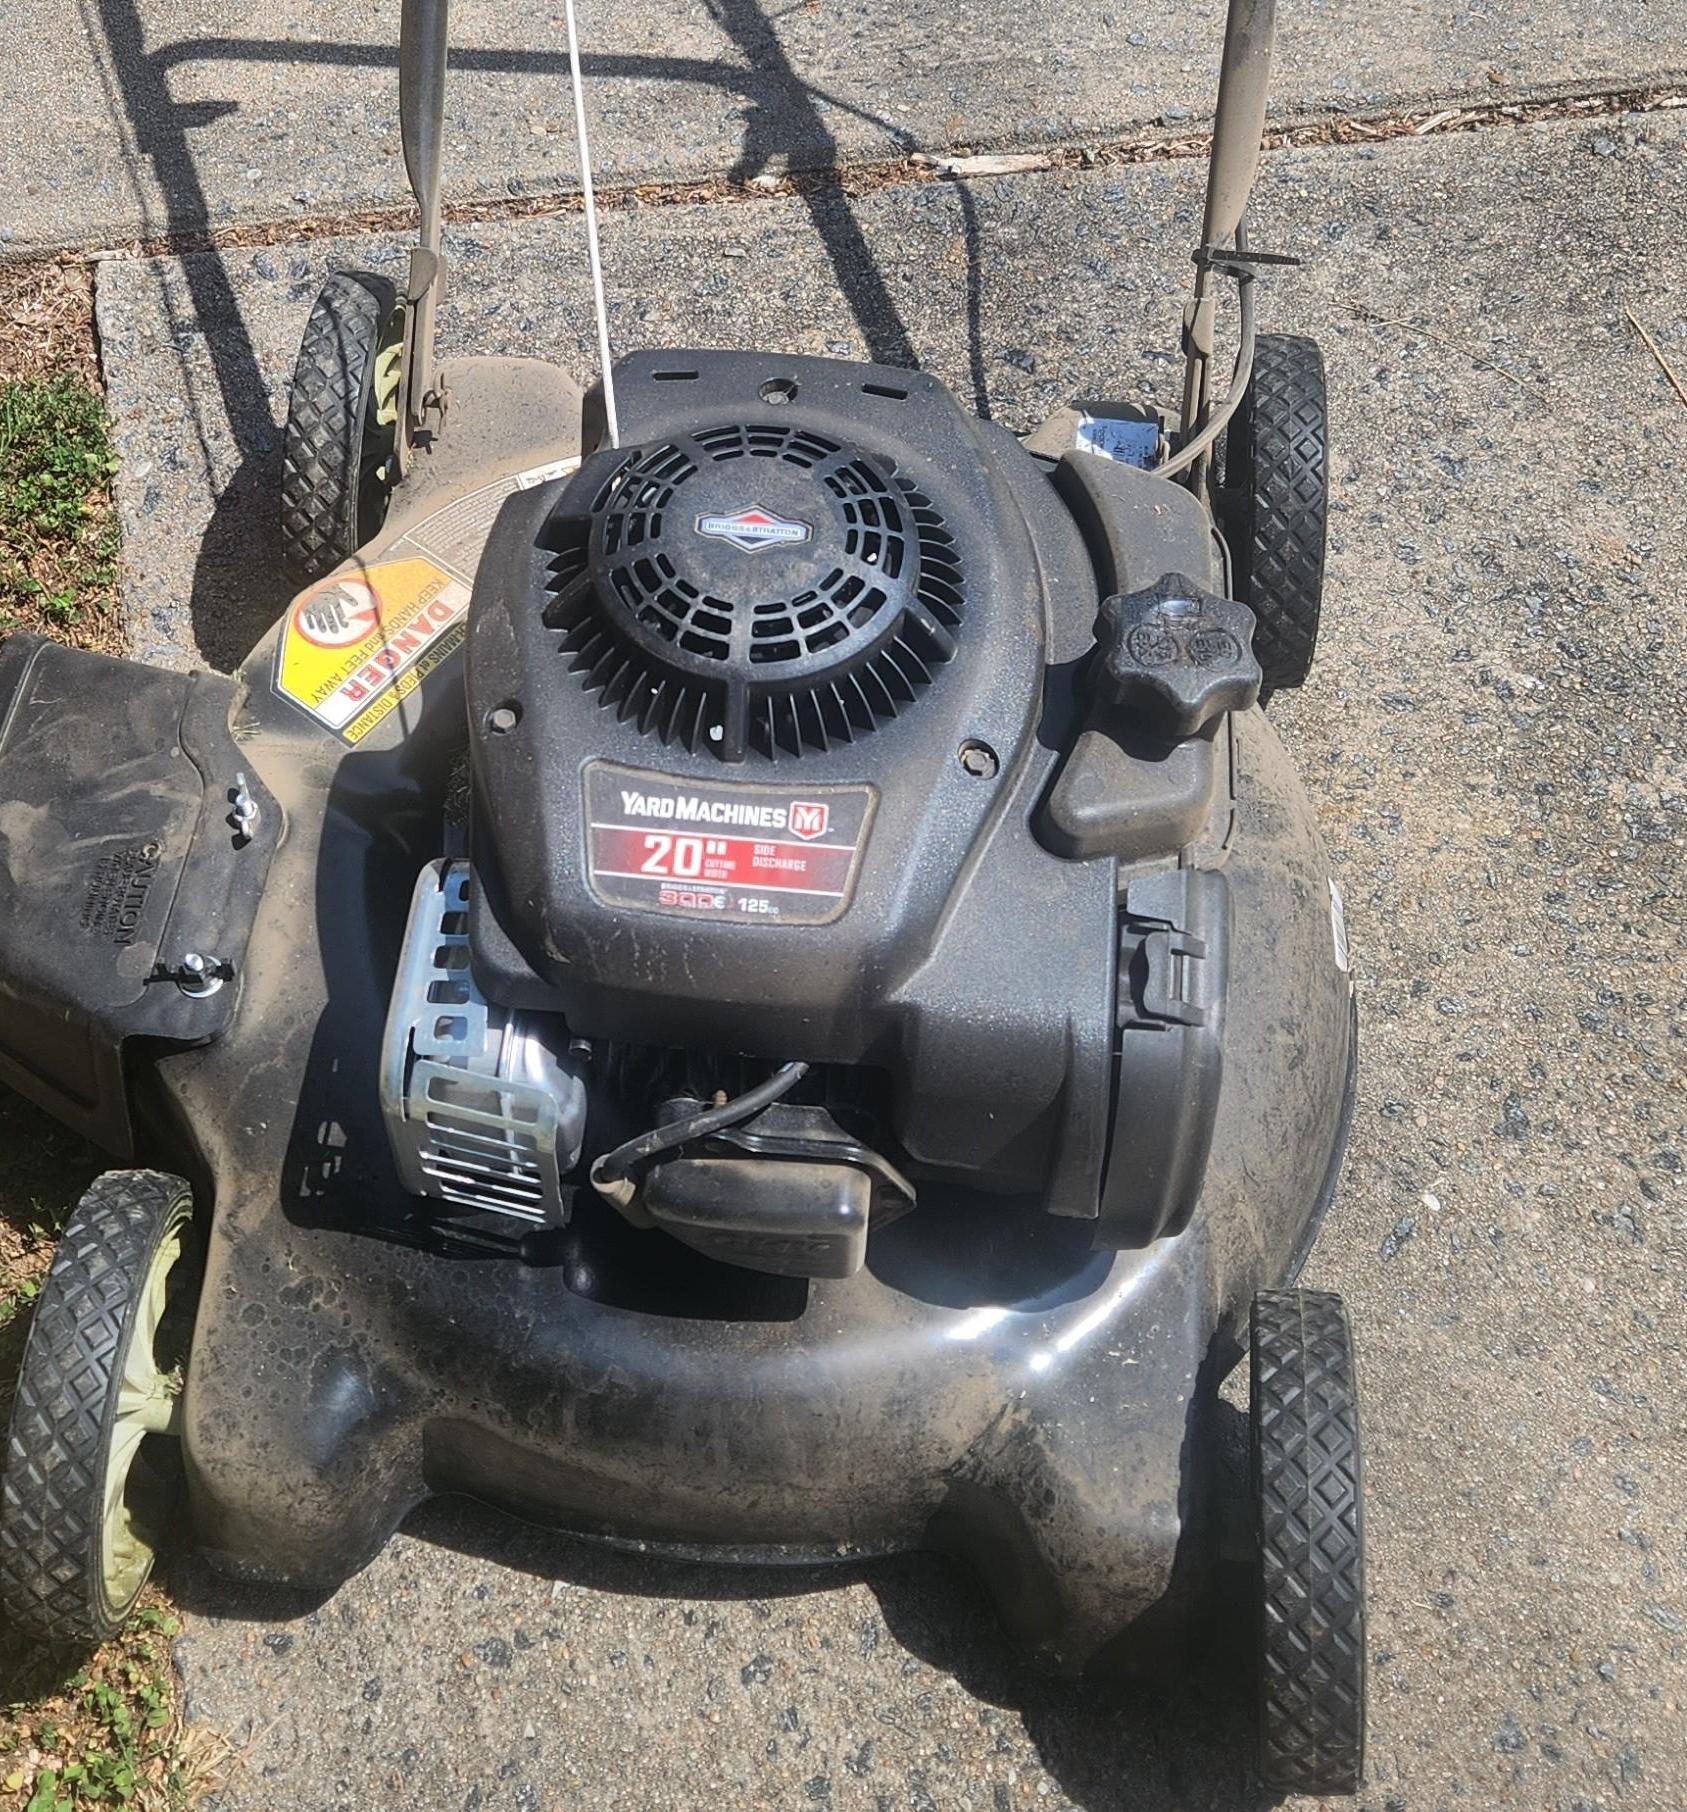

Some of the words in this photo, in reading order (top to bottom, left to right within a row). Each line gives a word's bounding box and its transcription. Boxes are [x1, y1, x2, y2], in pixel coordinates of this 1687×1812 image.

[416, 578, 444, 605] KEEP
[383, 602, 419, 636] HANDS
[339, 599, 455, 702] DANGER
[367, 632, 385, 653] and
[341, 649, 370, 675] FEET
[311, 672, 343, 704] AWAY
[394, 666, 425, 696] PIEDS
[344, 696, 393, 741] DISTANCE
[752, 857, 807, 872] DISCHARGE
[753, 843, 776, 856] SIDE
[113, 842, 161, 945] CAUTION
